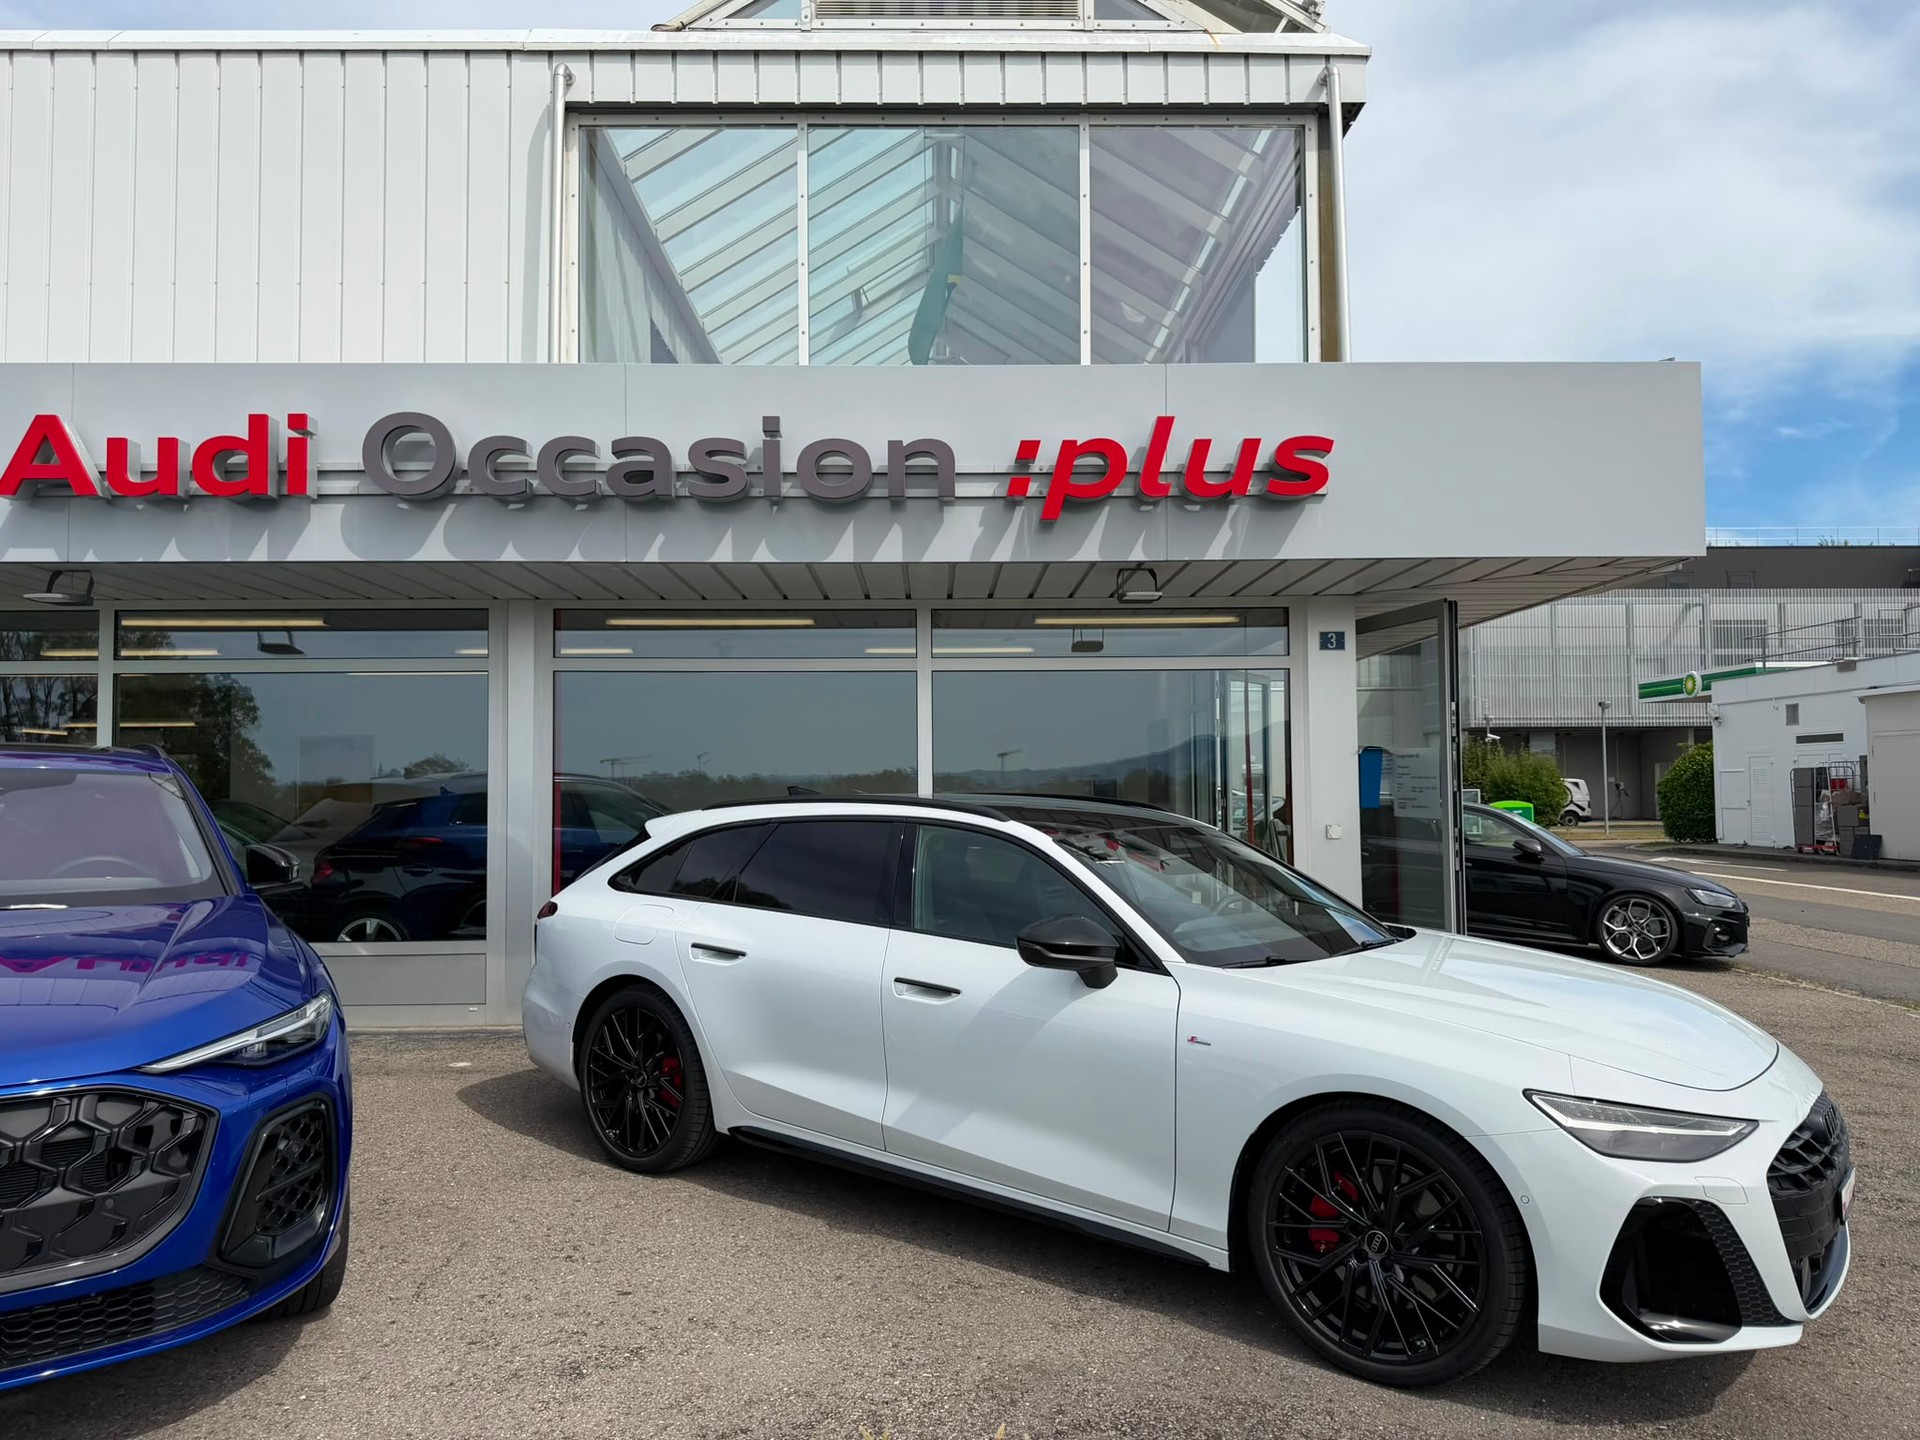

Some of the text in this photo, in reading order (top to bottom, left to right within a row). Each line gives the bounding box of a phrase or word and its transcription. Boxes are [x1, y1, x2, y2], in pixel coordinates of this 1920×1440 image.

[0, 412, 314, 499] Audi
[361, 411, 956, 501] Occasion
[1327, 632, 1336, 649] 3
